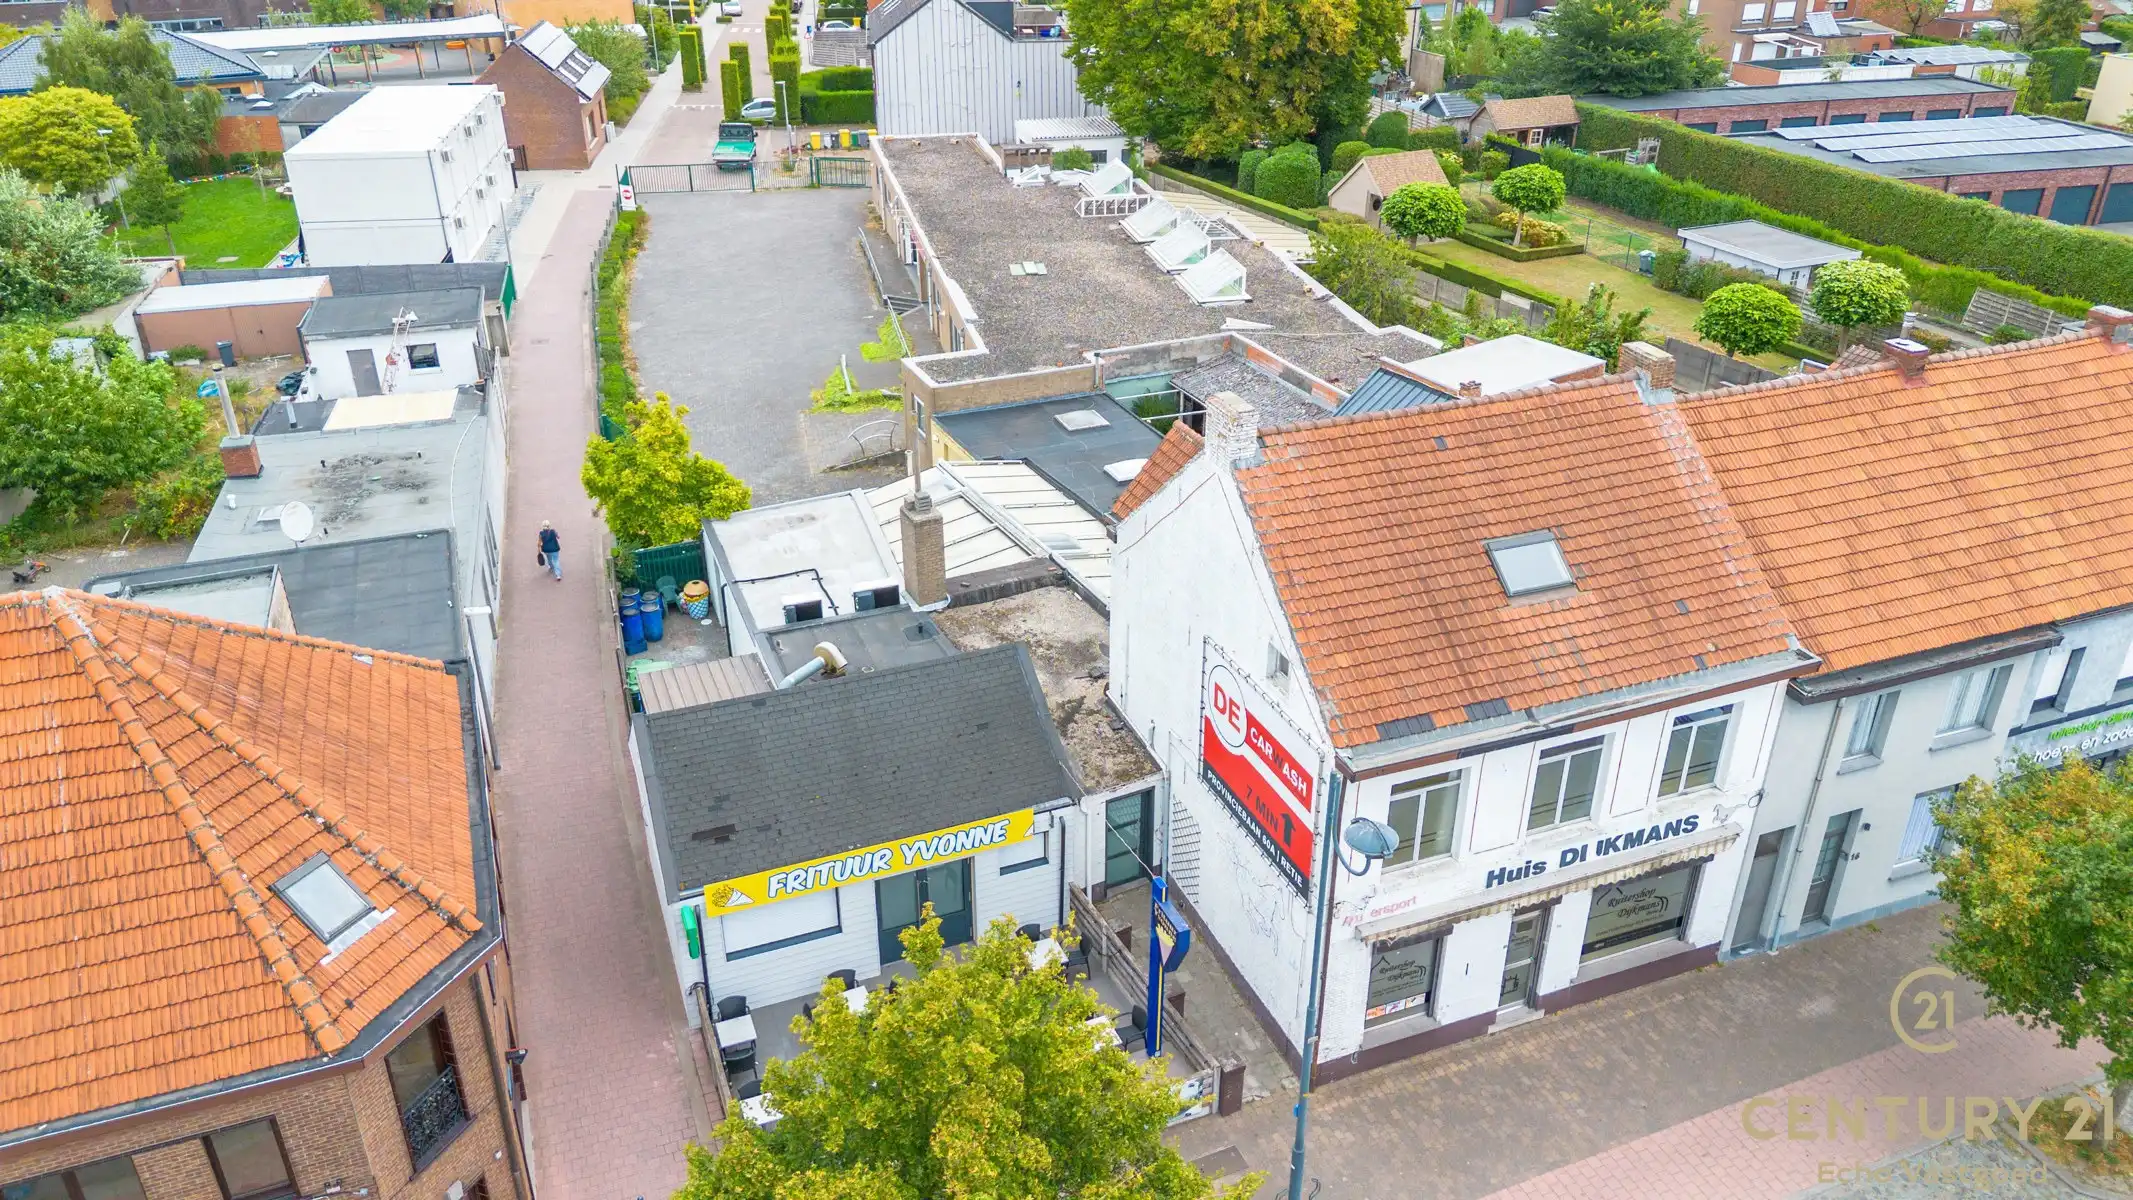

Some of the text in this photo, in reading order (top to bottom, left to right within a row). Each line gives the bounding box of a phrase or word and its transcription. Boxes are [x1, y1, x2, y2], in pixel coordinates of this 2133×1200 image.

[1213, 681, 1241, 734] DE
[1250, 727, 1308, 799] CARWASH
[1208, 769, 1262, 838] PROVINCIEBAAN
[1281, 855, 1303, 888] RETIE
[1245, 784, 1279, 833] 7 MIN
[767, 818, 1012, 899] FRITUUR YVONNE
[1486, 860, 1548, 889] Huis
